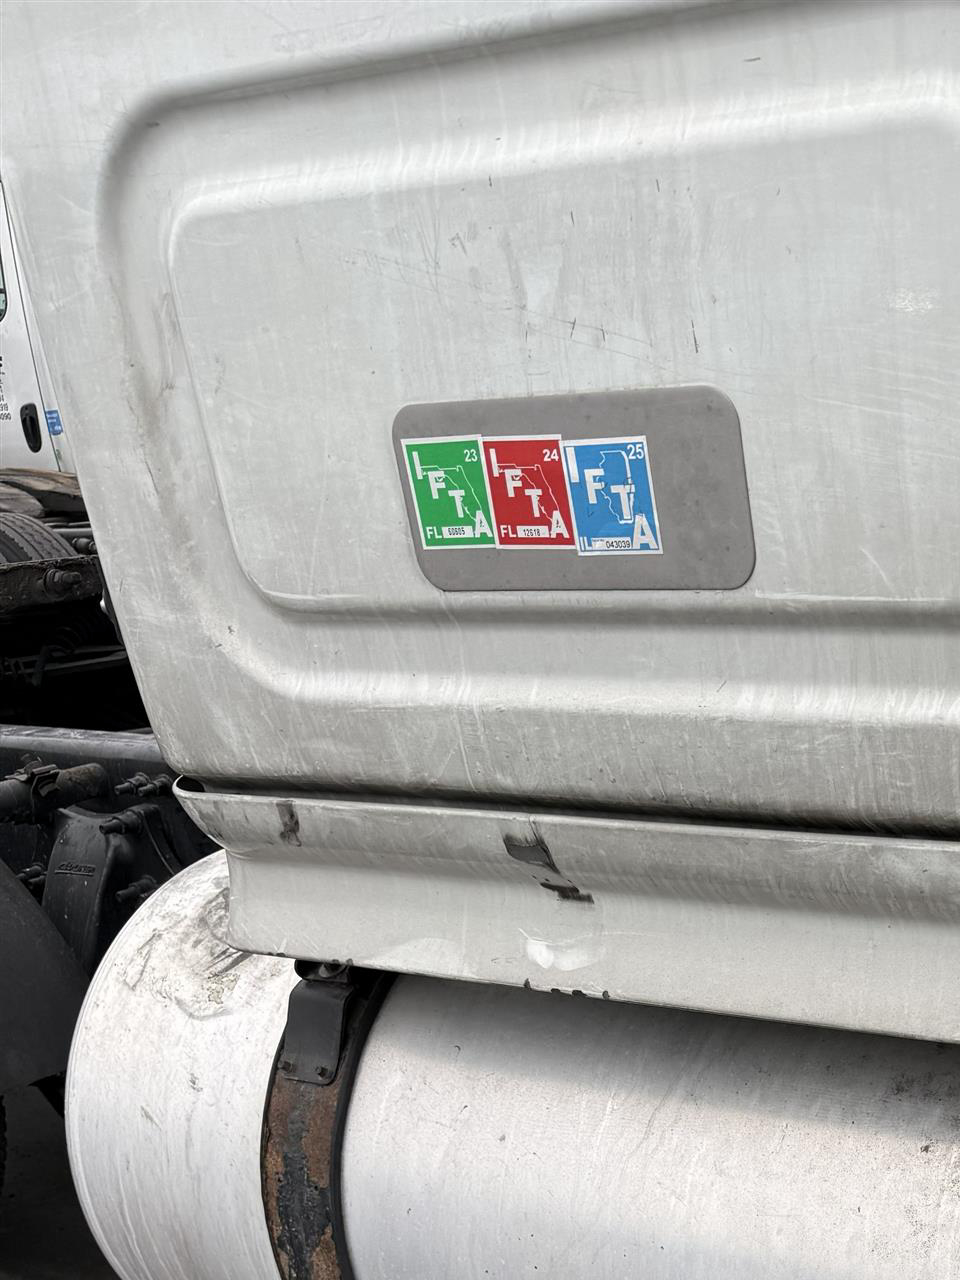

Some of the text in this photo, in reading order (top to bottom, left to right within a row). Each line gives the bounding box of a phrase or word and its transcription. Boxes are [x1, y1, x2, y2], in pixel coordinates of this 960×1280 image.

[463, 449, 479, 463] 23
[542, 448, 559, 462] 24
[627, 443, 644, 459] 25
[425, 526, 443, 539] FL
[500, 525, 517, 538] FL
[605, 540, 631, 549] 043039
